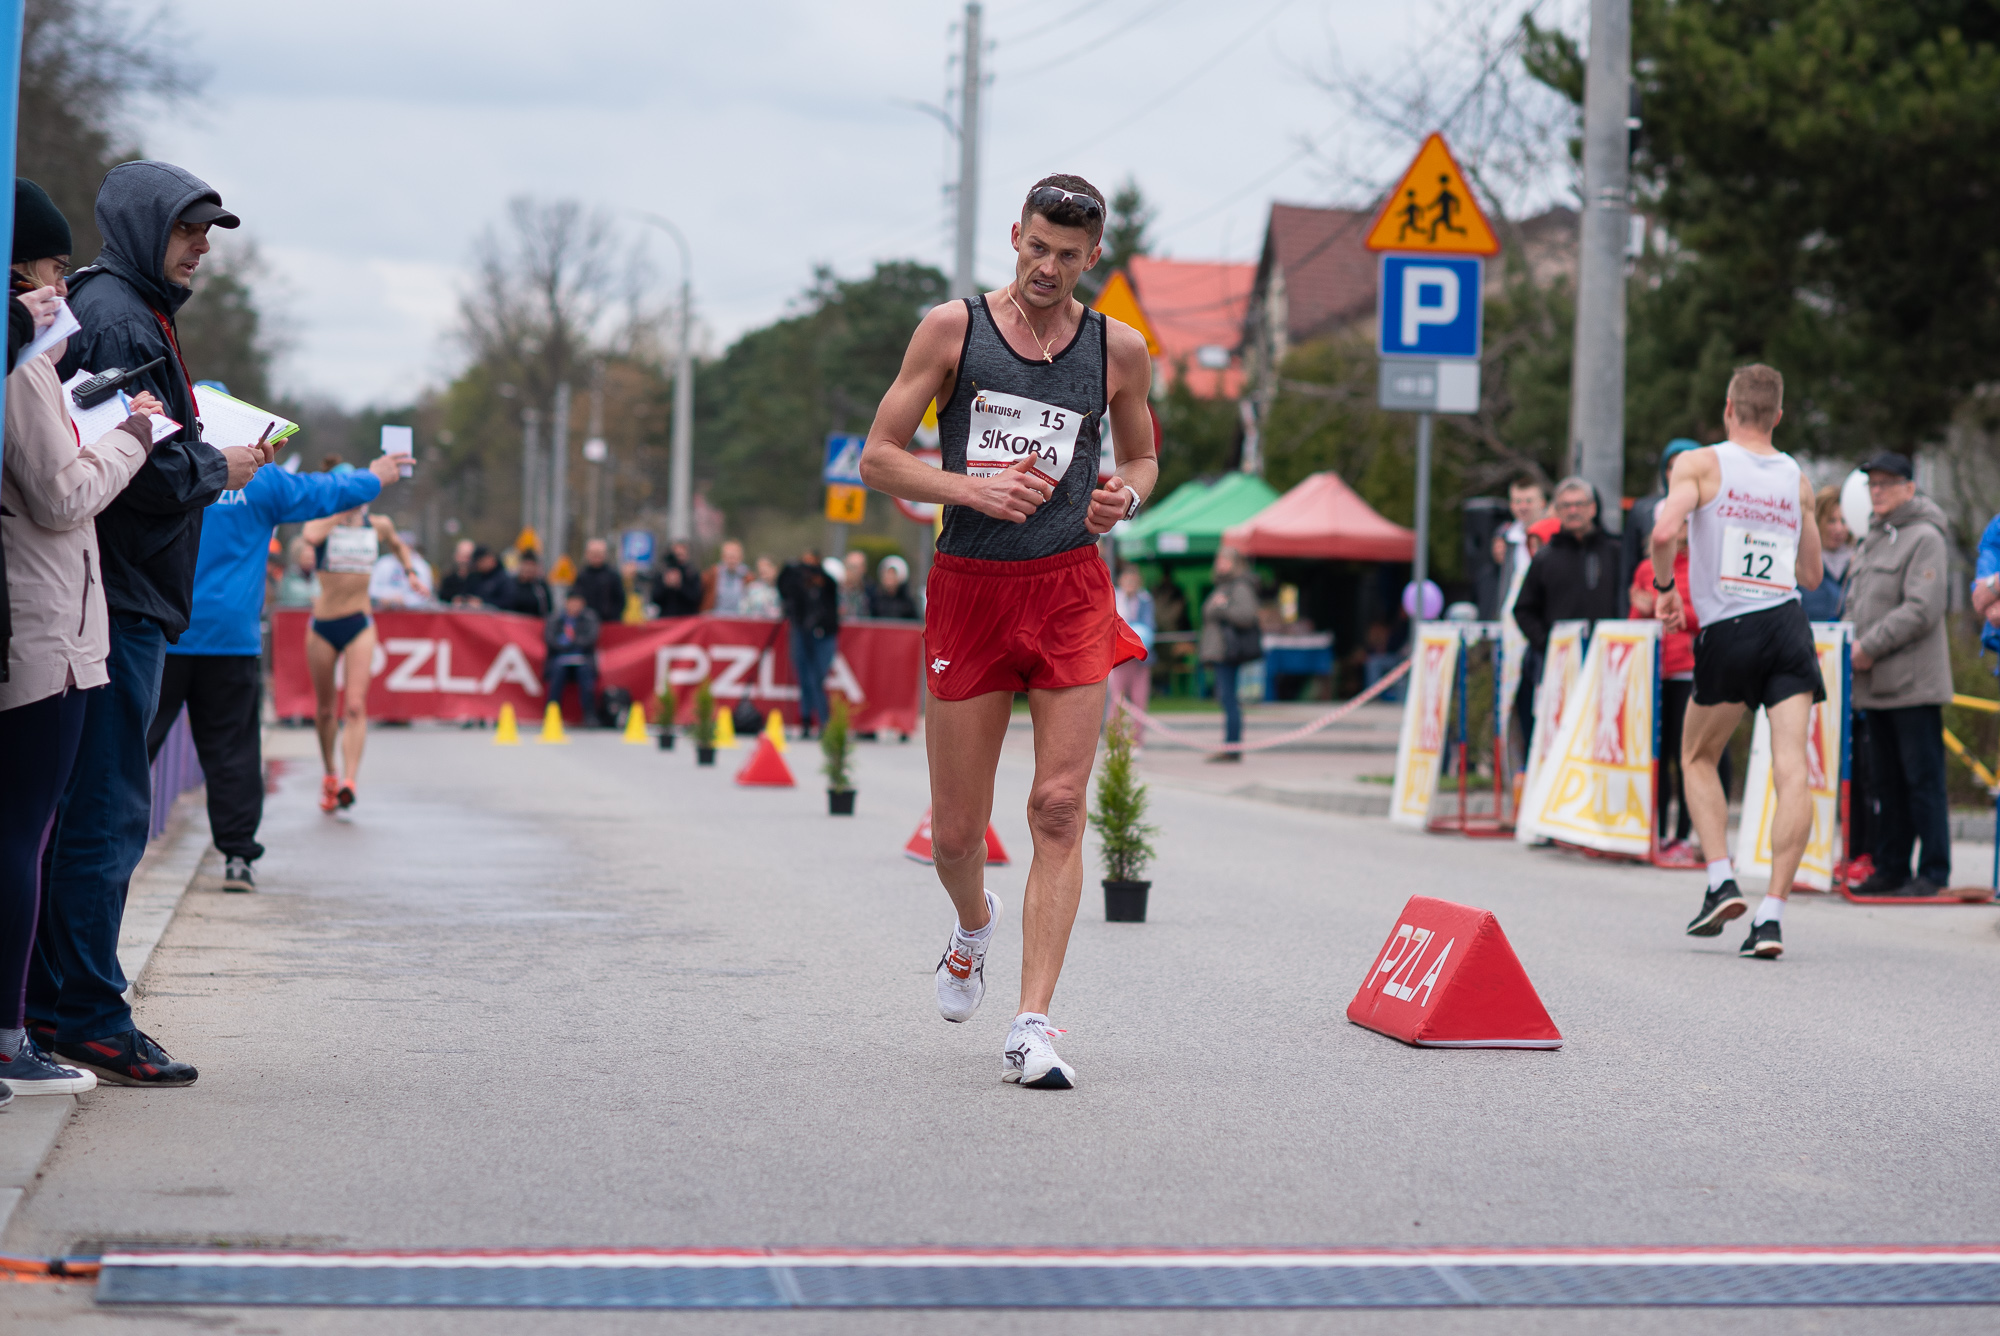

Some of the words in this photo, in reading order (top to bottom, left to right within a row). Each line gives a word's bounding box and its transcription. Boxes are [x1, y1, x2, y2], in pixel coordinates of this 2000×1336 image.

[1401, 266, 1460, 346] P
[1040, 410, 1066, 431] 15
[978, 428, 1058, 466] SIKORA
[1742, 552, 1774, 580] 12
[1366, 923, 1455, 1008] PZLA
